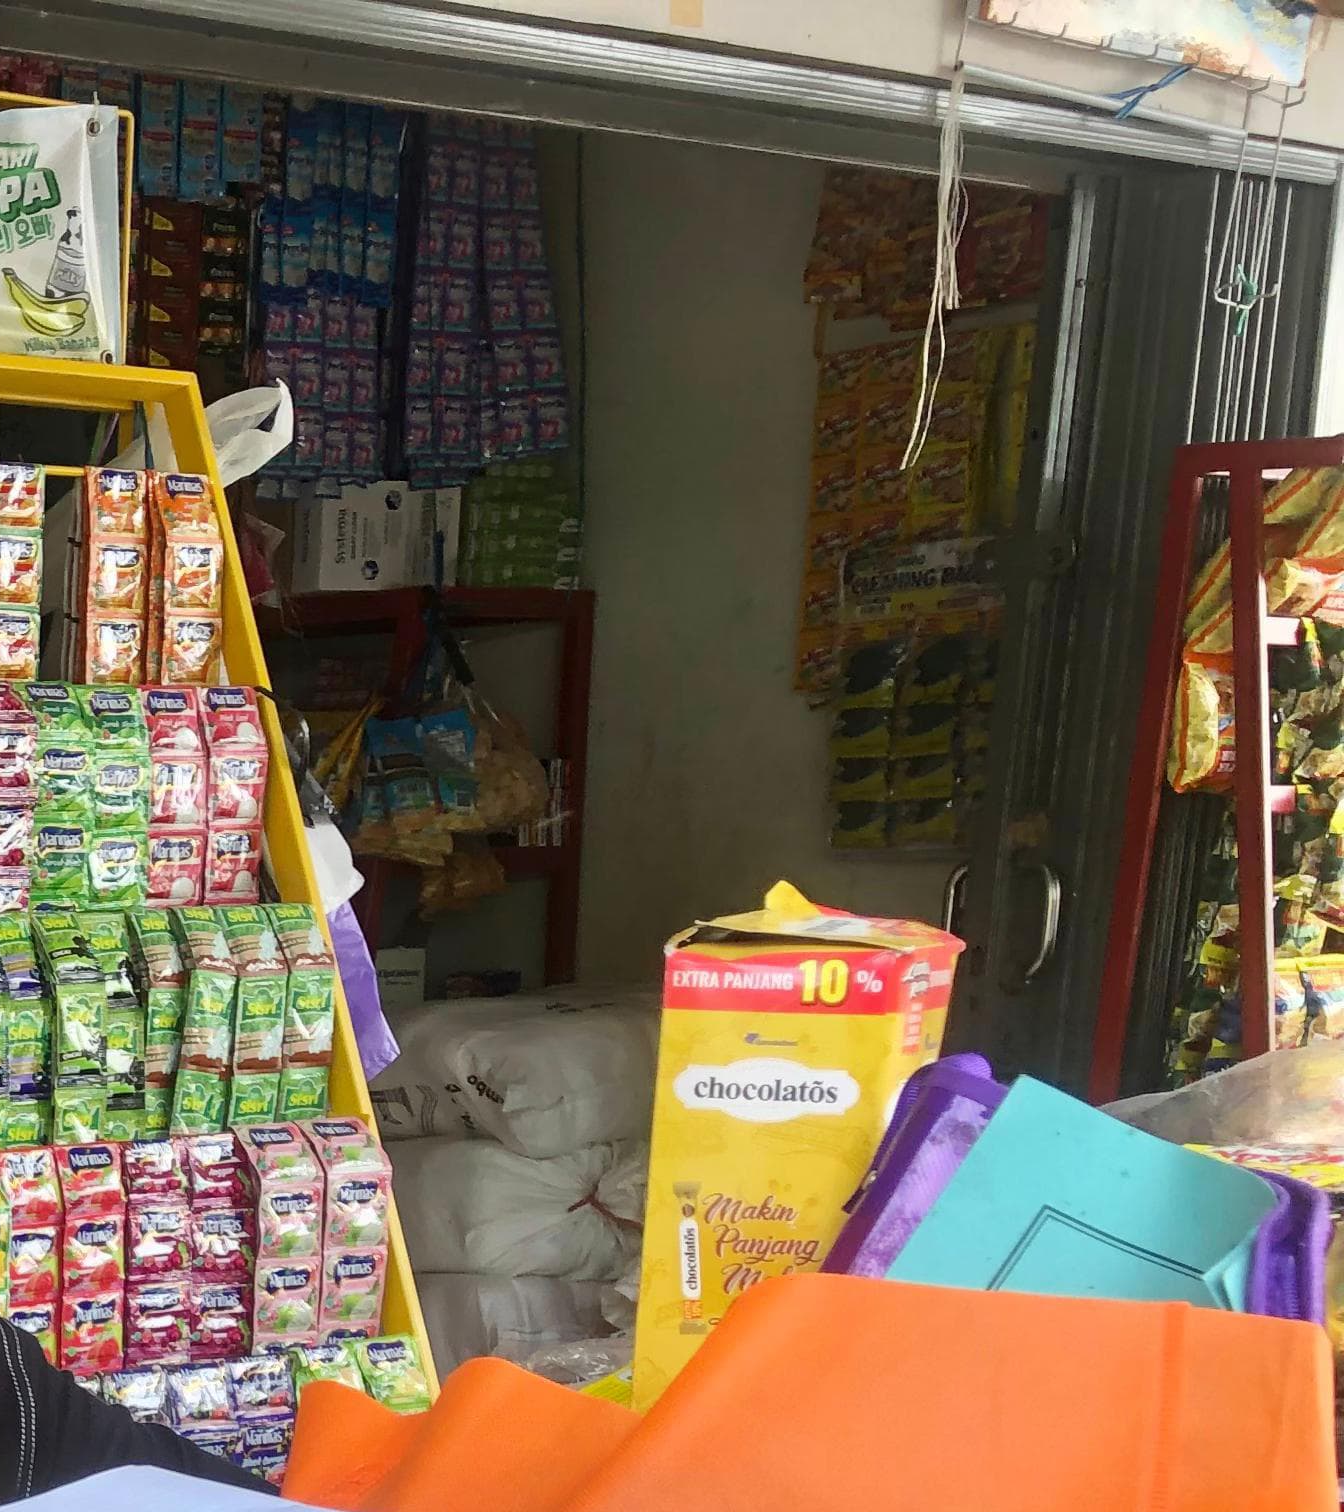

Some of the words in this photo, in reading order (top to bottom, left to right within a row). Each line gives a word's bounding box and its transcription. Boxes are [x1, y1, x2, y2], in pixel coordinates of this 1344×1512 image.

[671, 969, 720, 990] EXTRA
[722, 972, 794, 993] PANJANG
[798, 958, 850, 1007] 10
[855, 969, 884, 994] %
[700, 1191, 801, 1224] Makin
[712, 1224, 824, 1265] Panjang
